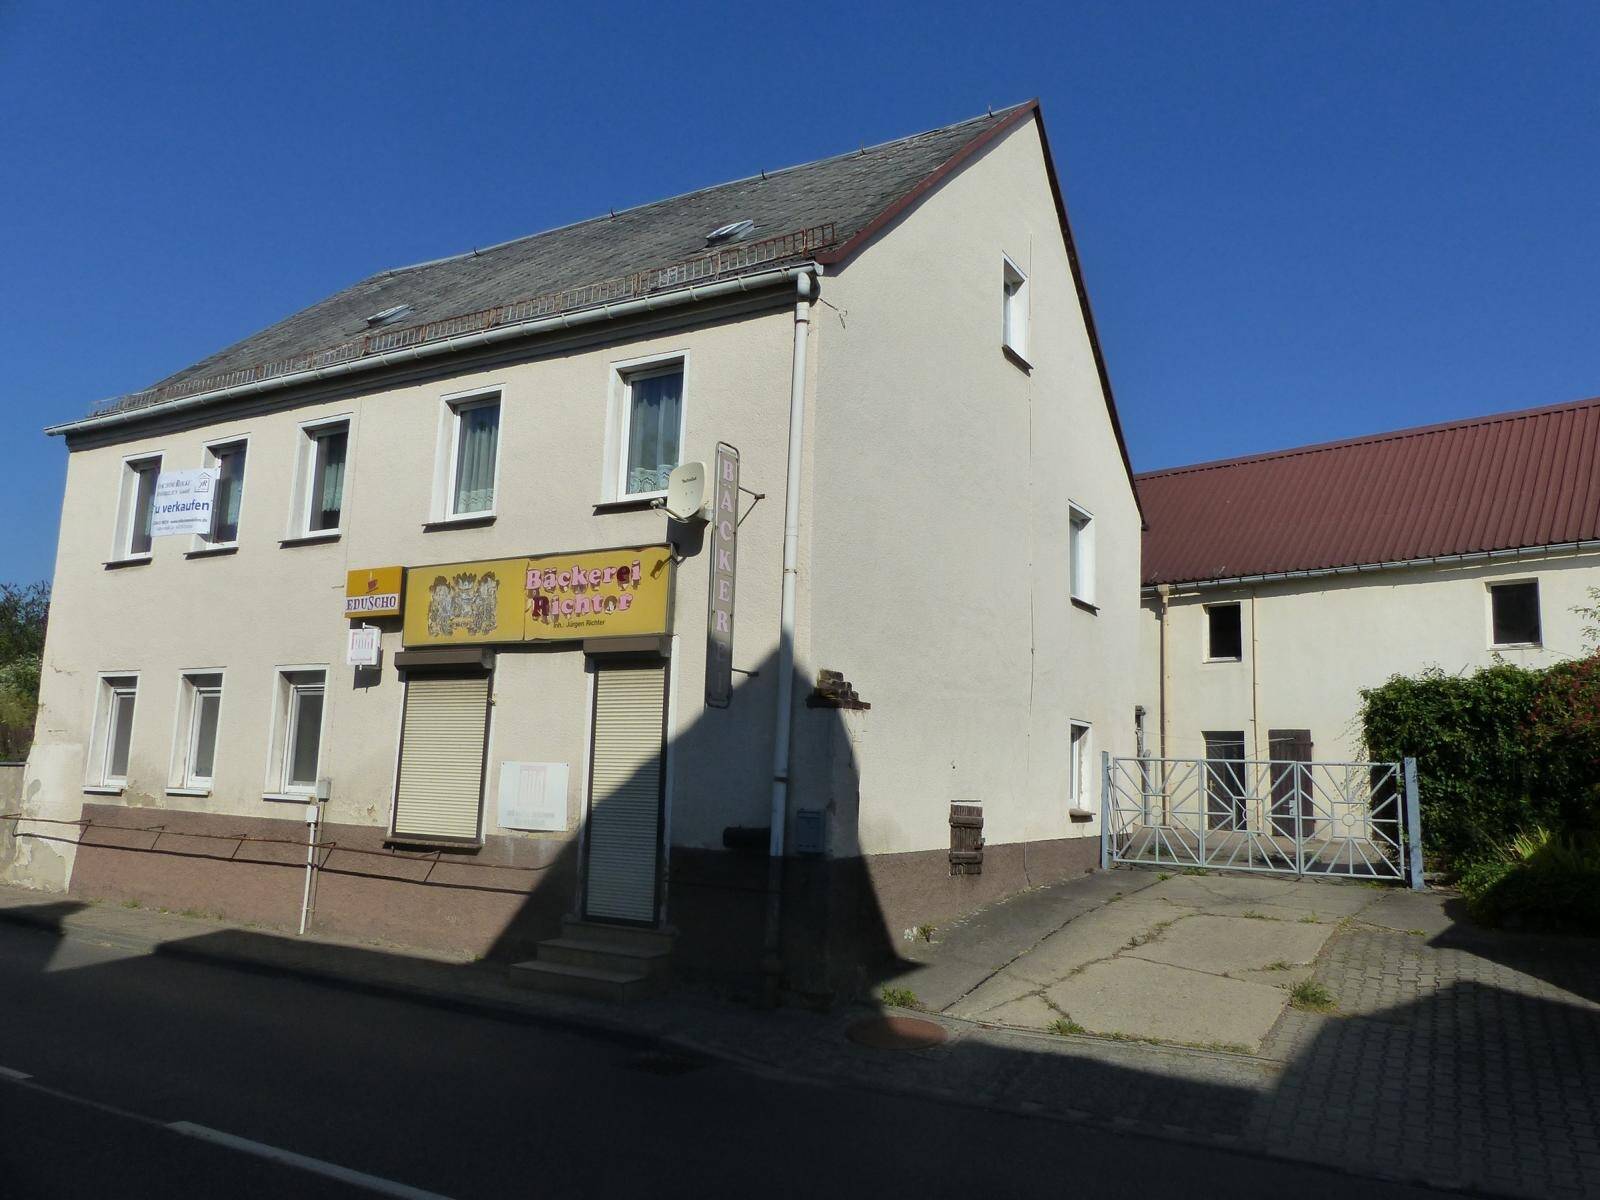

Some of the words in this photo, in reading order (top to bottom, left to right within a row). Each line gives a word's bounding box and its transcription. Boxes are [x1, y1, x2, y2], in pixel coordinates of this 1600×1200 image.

[162, 499, 210, 513] verkaufen
[526, 560, 641, 590] Bäckerei
[346, 596, 397, 611] EDUSCHO
